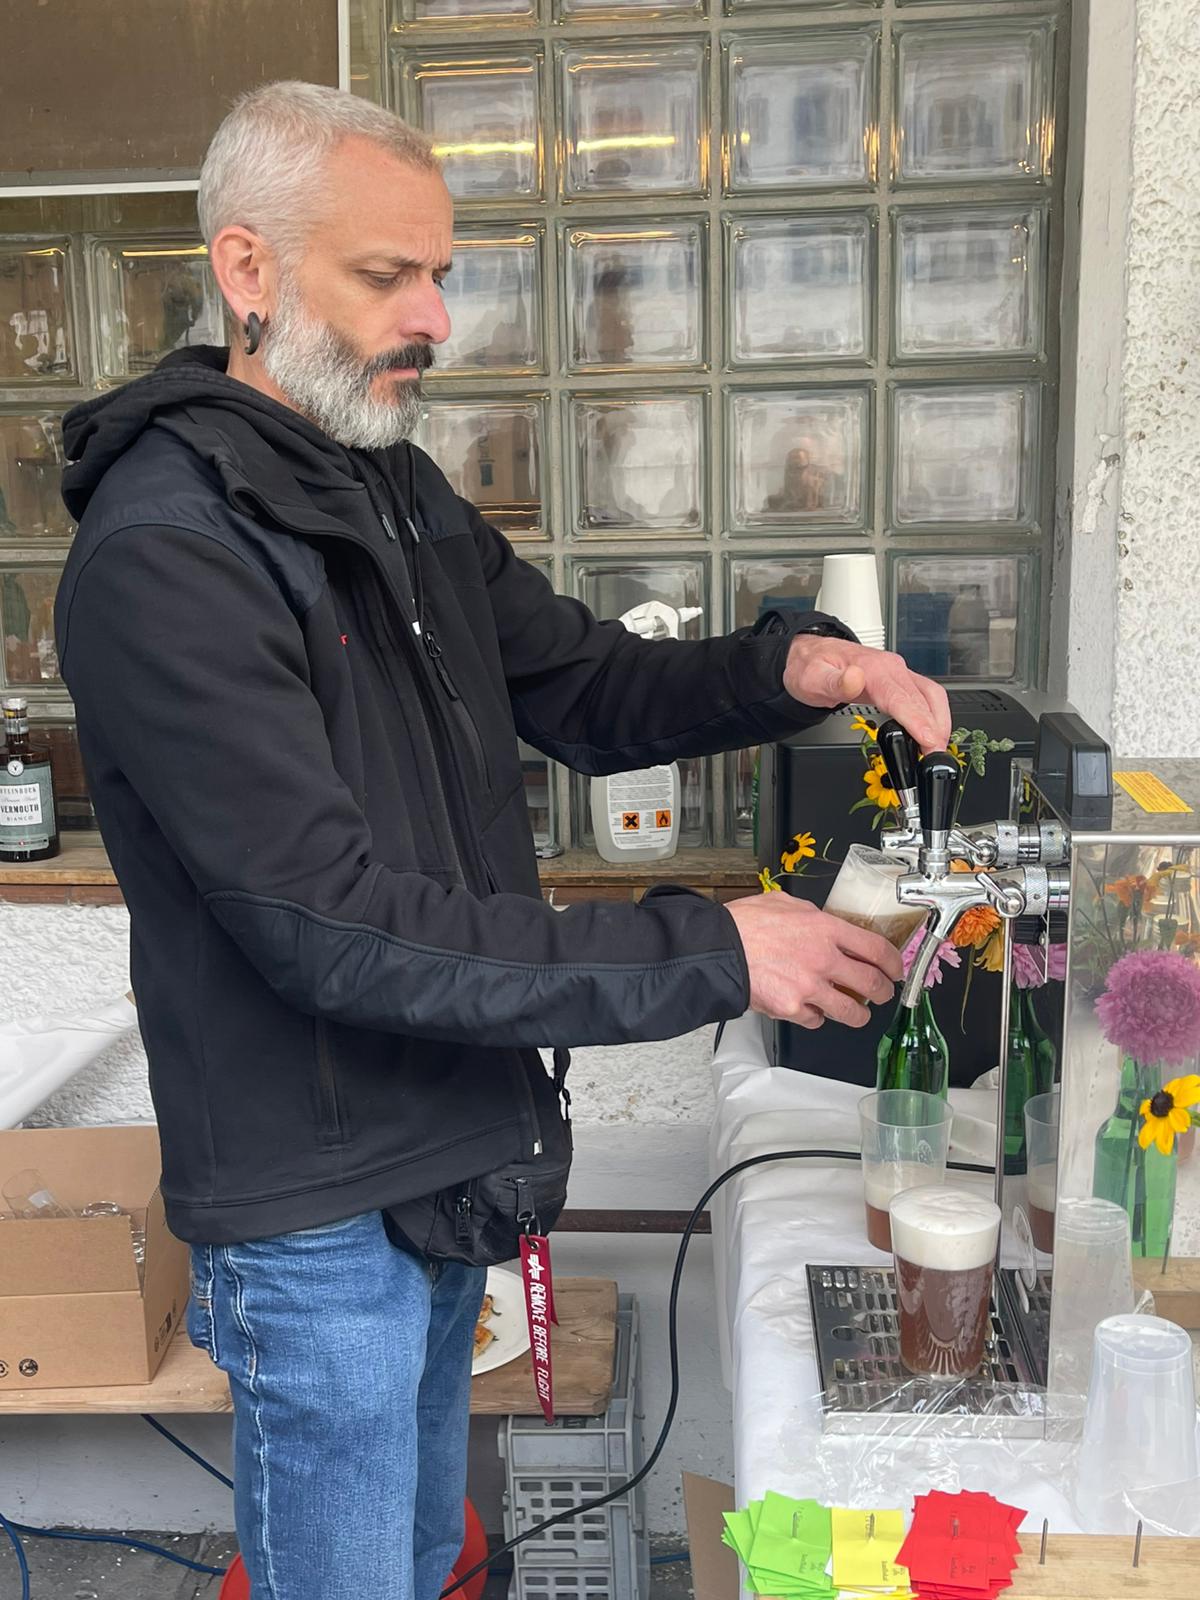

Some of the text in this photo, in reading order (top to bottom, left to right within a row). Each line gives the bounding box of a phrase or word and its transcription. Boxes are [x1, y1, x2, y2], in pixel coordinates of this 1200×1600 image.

[0, 804, 39, 813] VERMOUTH
[530, 1282, 550, 1402] REMOVE BEFORE FLIGHT
